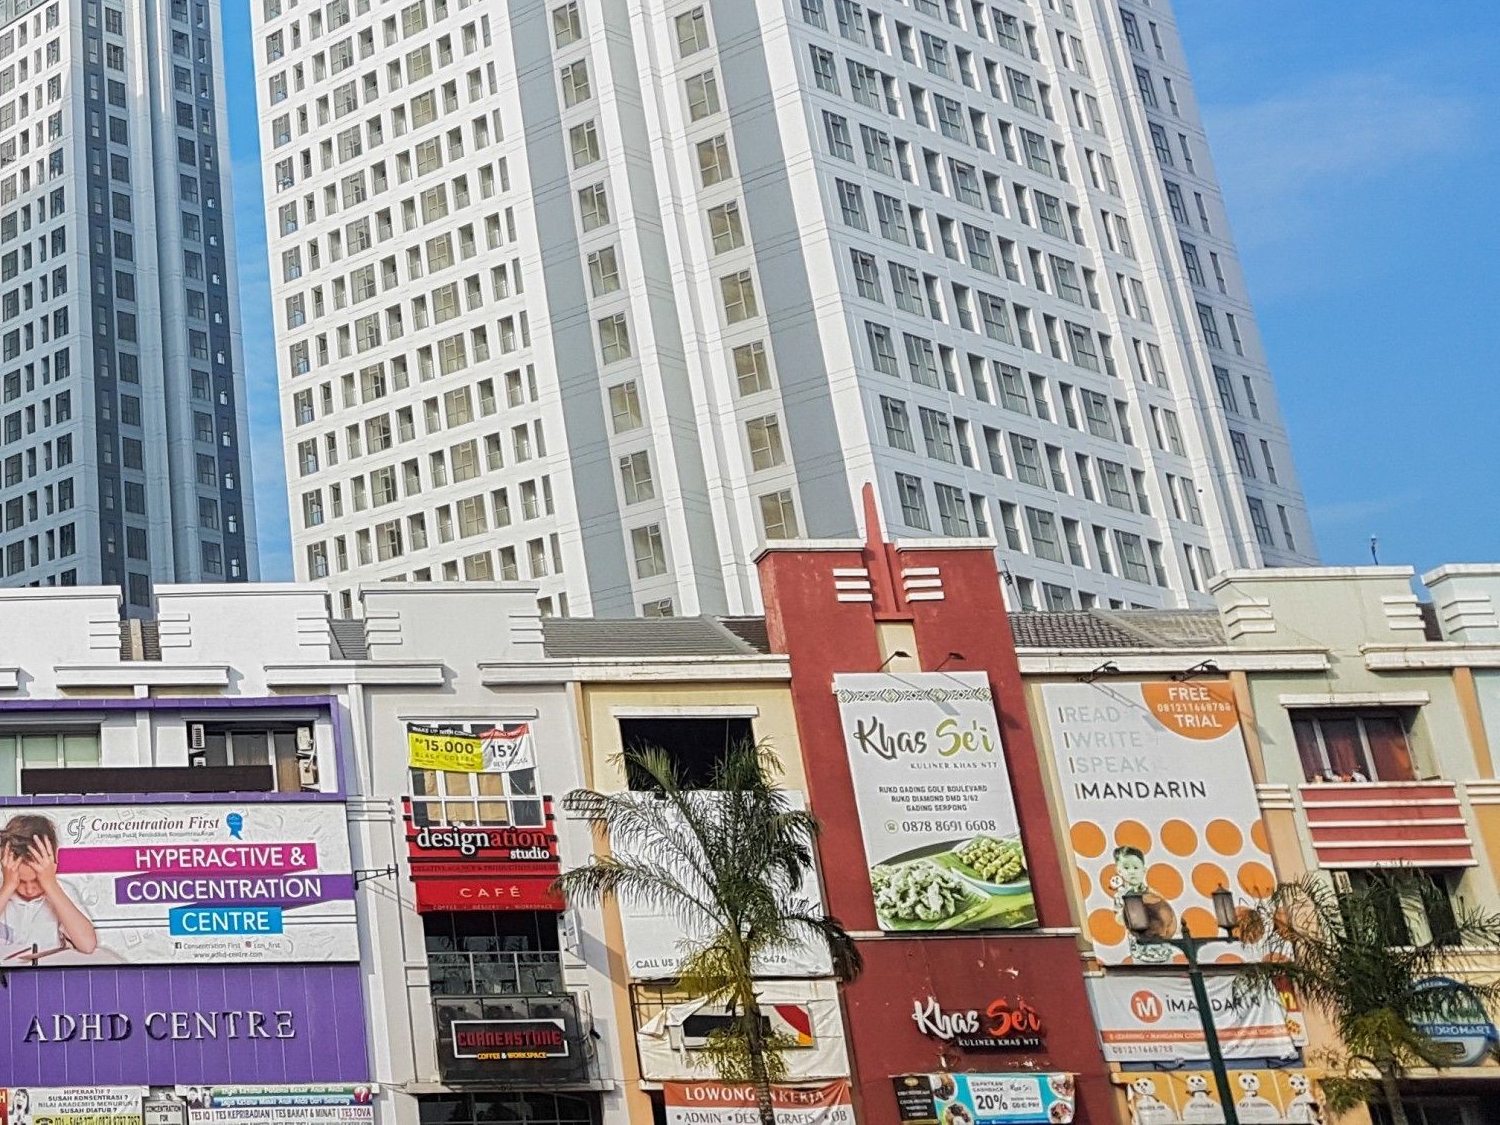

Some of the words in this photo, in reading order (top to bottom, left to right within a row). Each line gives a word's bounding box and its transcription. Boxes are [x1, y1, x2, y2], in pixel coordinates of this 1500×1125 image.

[1168, 687, 1211, 701] FREE
[1174, 714, 1223, 728] TRIAL
[853, 716, 928, 760] Khas
[424, 739, 474, 755] 15.000
[489, 744, 519, 758] 15%
[91, 816, 187, 831] Concentration
[188, 816, 220, 830] First
[902, 821, 932, 832] 0878
[935, 821, 962, 832] 8691
[965, 820, 997, 831] 6608
[417, 826, 548, 855] designation
[136, 846, 283, 869] HYPERACTIVE
[290, 847, 307, 866] &
[510, 847, 550, 860] studio
[126, 877, 322, 901] CONCENTRATION
[459, 885, 521, 898] CAFÉ
[182, 910, 270, 932] CENTRE
[635, 960, 660, 969] CALL
[662, 959, 674, 967] US
[911, 996, 980, 1040] Khas
[23, 1012, 132, 1043] ADHD
[145, 1010, 298, 1041] CENTRE
[457, 1030, 563, 1047] CORNERSTONE
[959, 1038, 994, 1046] KULINER
[997, 1038, 1020, 1046] KHAS
[477, 1052, 500, 1060] COFFEE
[501, 1052, 507, 1060] &
[507, 1051, 548, 1059] WORKSPACE
[685, 1086, 778, 1101] LOWONGN
[975, 1094, 1009, 1110] 20%
[215, 1110, 226, 1120] TES
[227, 1109, 270, 1119] KEPRIBADIAN
[275, 1109, 286, 1119] TES
[341, 1108, 353, 1117] TES
[684, 1112, 722, 1124] ADMIN
[776, 1112, 815, 1125] GRAFIS
